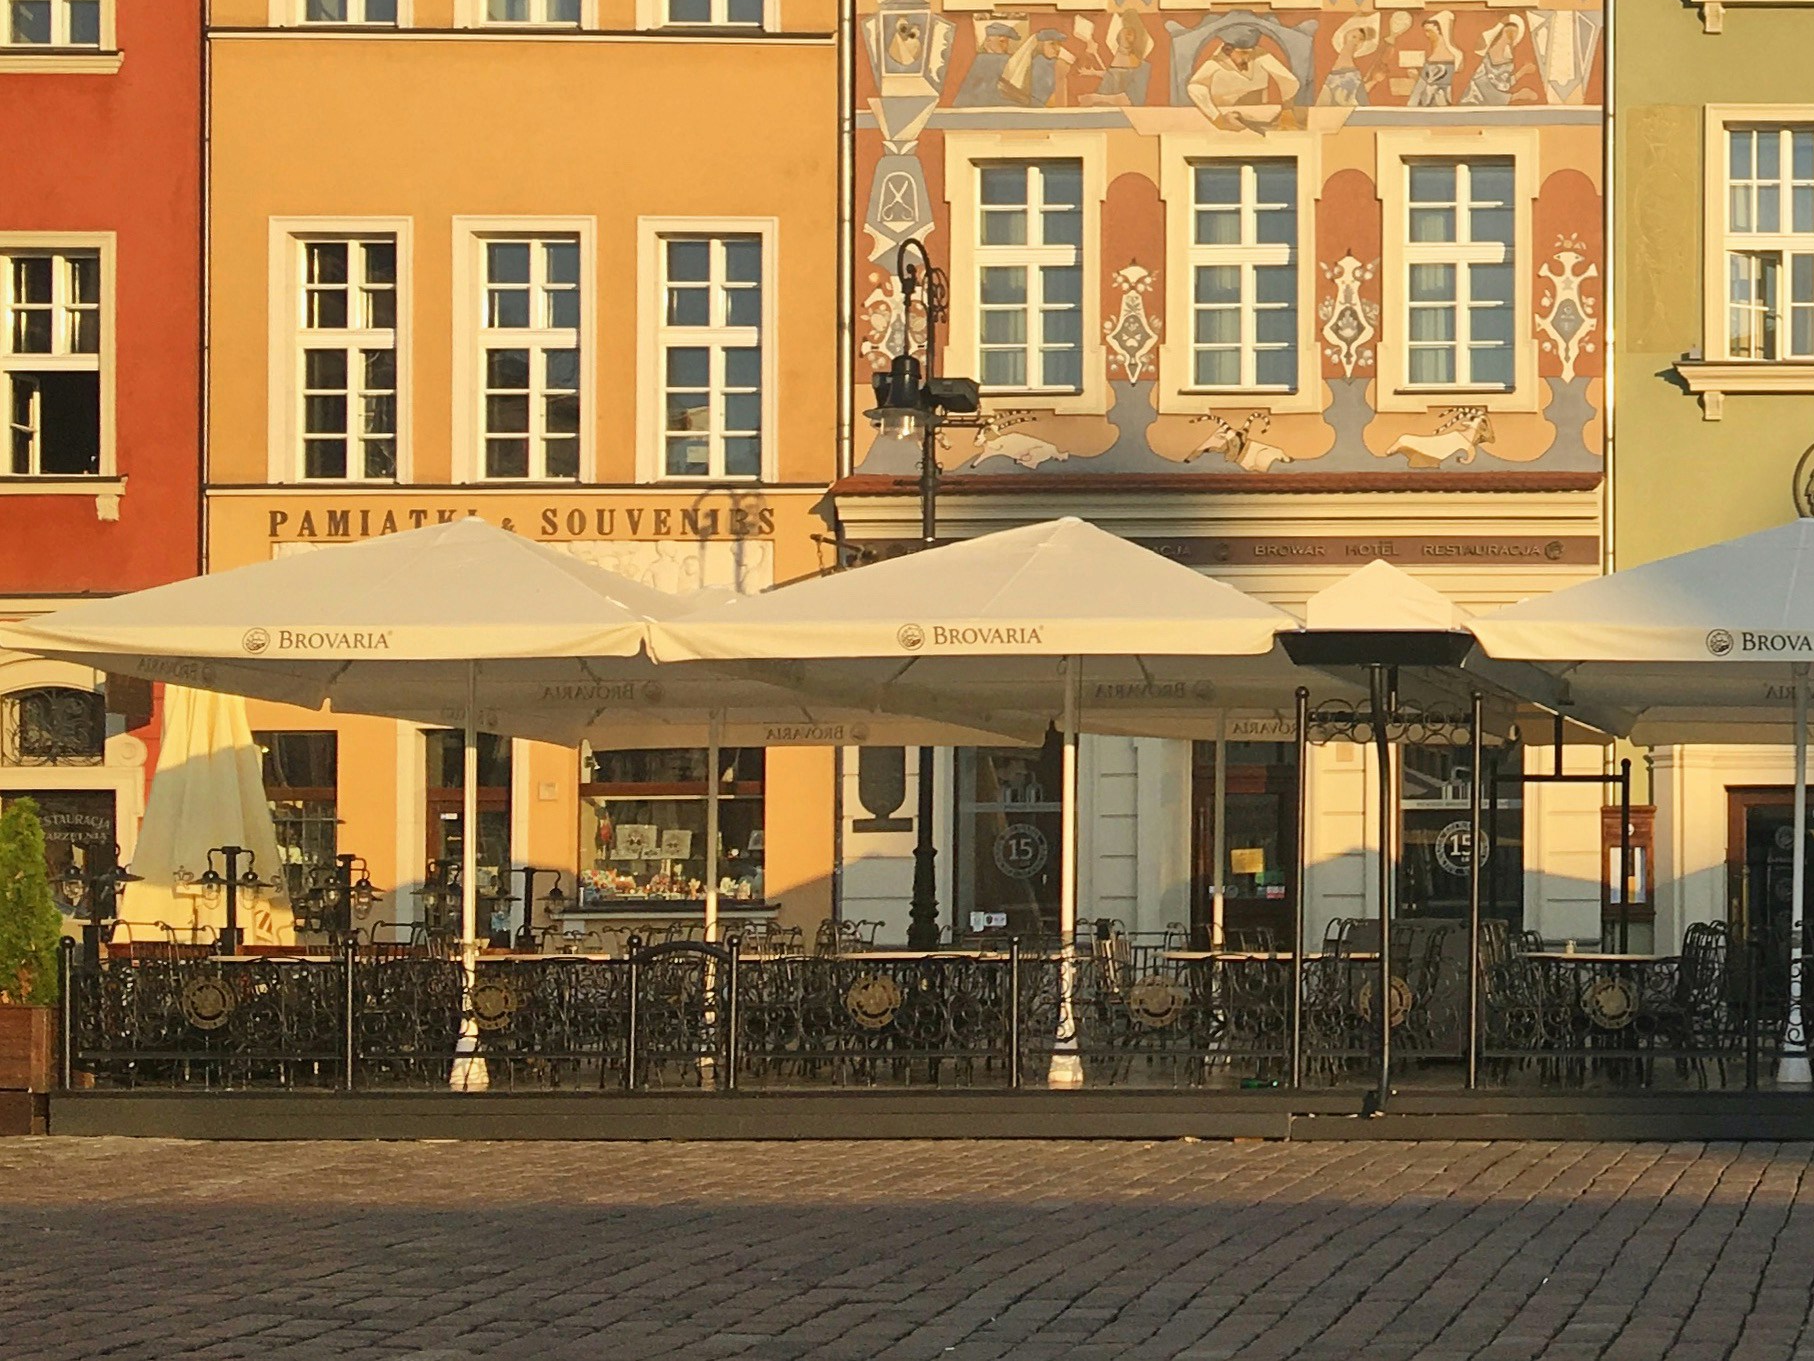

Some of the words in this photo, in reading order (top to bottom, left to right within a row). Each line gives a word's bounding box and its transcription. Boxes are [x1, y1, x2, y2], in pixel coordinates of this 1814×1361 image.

[268, 509, 479, 537] PAMIATK
[501, 517, 517, 534] &
[541, 508, 775, 536] SOUVENIRS
[1253, 544, 1326, 557] BROWAR
[1345, 543, 1400, 557] HOTEL
[1422, 544, 1542, 557] RESTAURACJA
[278, 630, 389, 650] BROVARIA
[933, 626, 1042, 645] BROVARIA
[1009, 838, 1034, 861] 15
